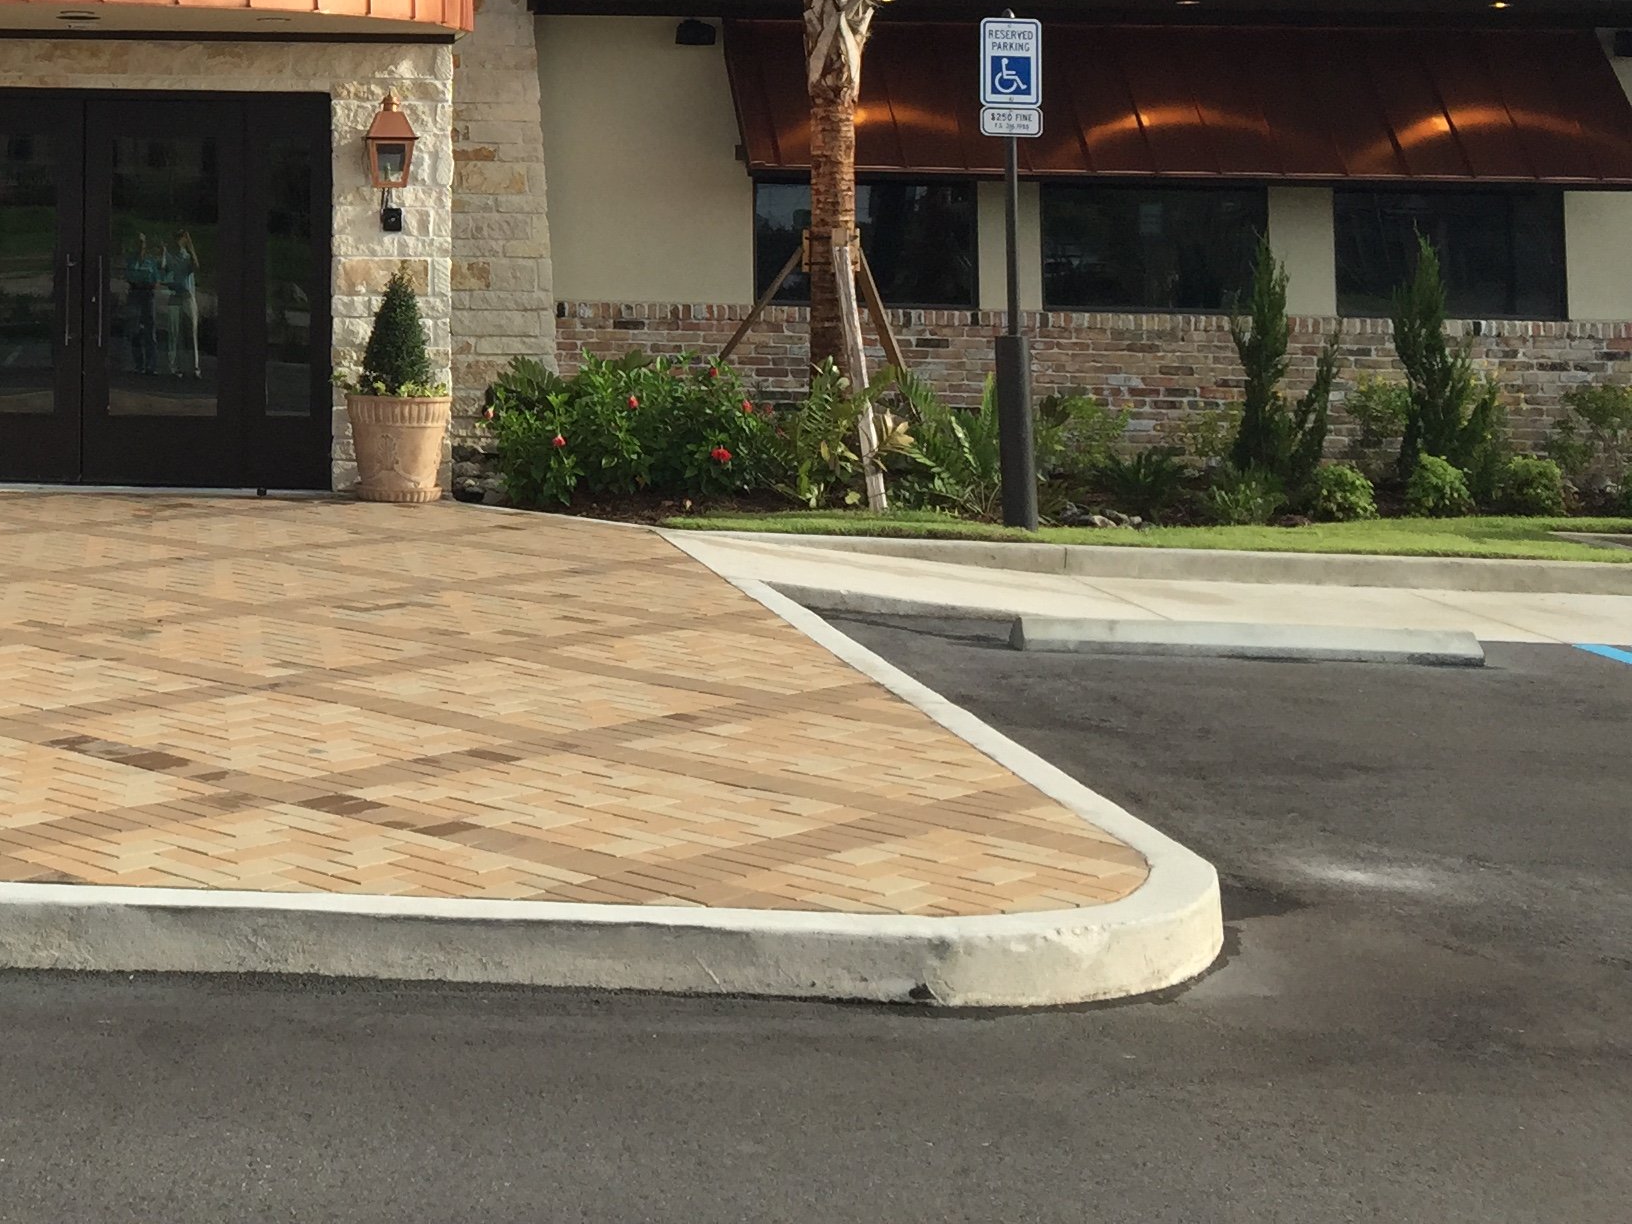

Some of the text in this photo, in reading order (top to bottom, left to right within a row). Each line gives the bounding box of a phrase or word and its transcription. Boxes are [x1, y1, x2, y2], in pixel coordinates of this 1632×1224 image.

[988, 29, 1034, 41] RESERVED
[991, 41, 1030, 52] PARKING
[991, 112, 1033, 122] $250 FINE
